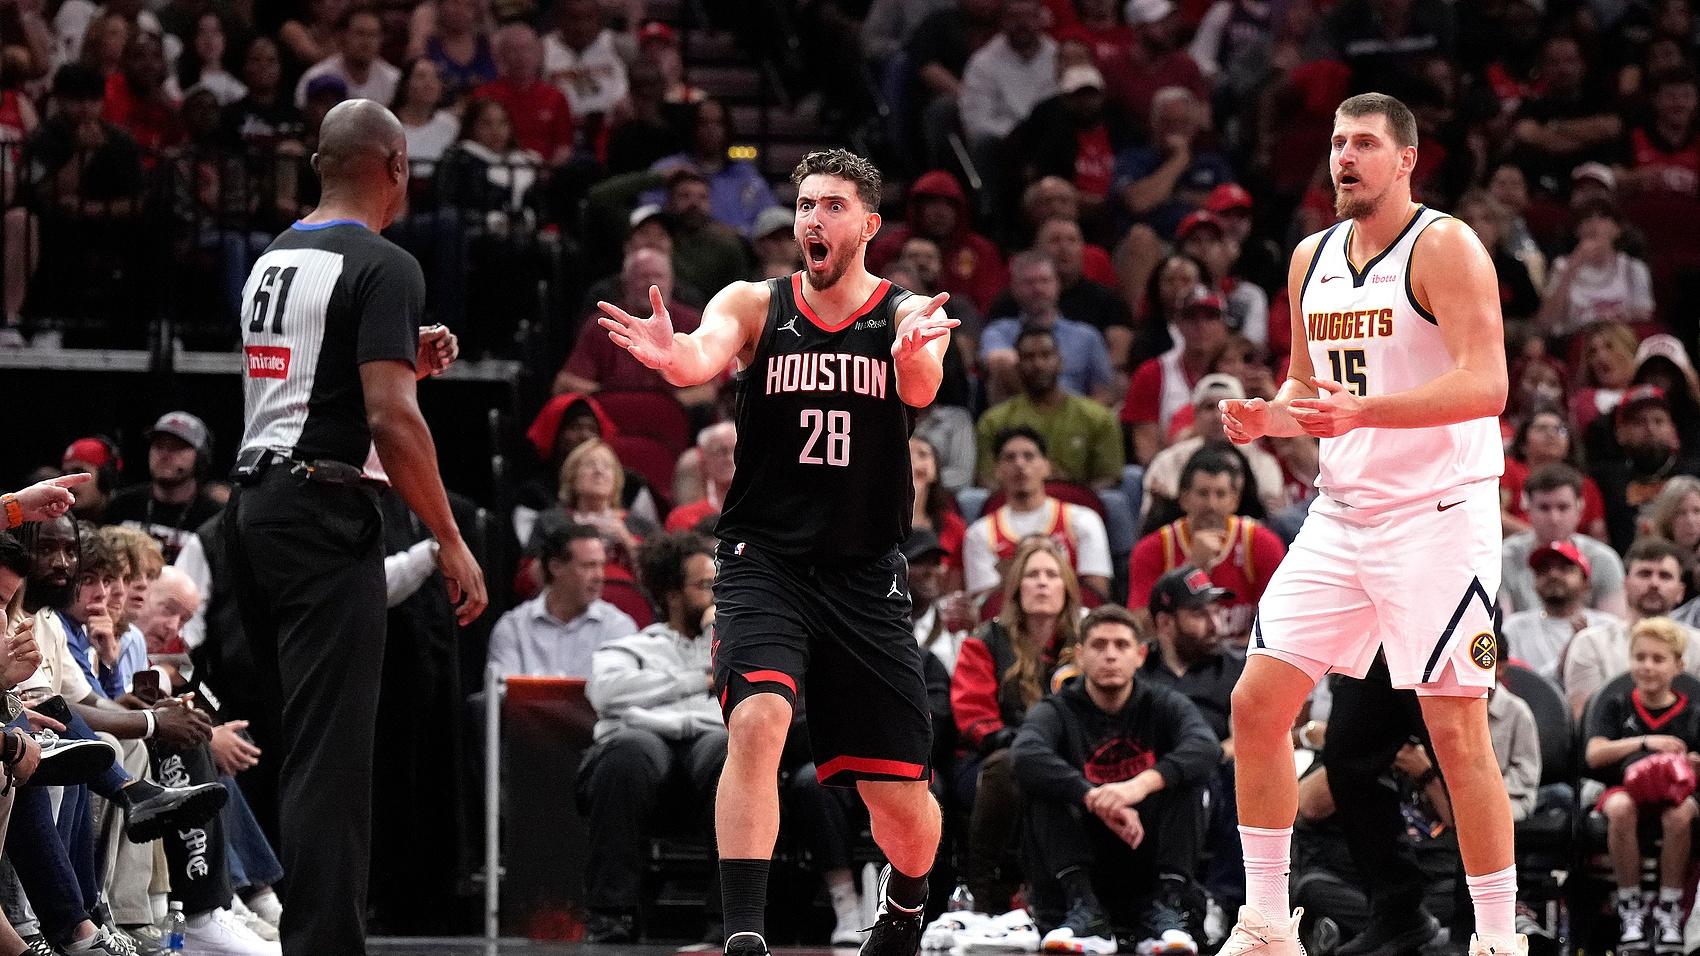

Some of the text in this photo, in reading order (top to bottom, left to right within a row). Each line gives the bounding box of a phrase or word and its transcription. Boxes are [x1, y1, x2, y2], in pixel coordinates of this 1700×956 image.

[249, 266, 298, 334] 61
[1308, 308, 1393, 342] NUGGETS
[765, 352, 888, 399] HOUSTON
[1327, 348, 1367, 397] 15
[799, 408, 851, 467] 28
